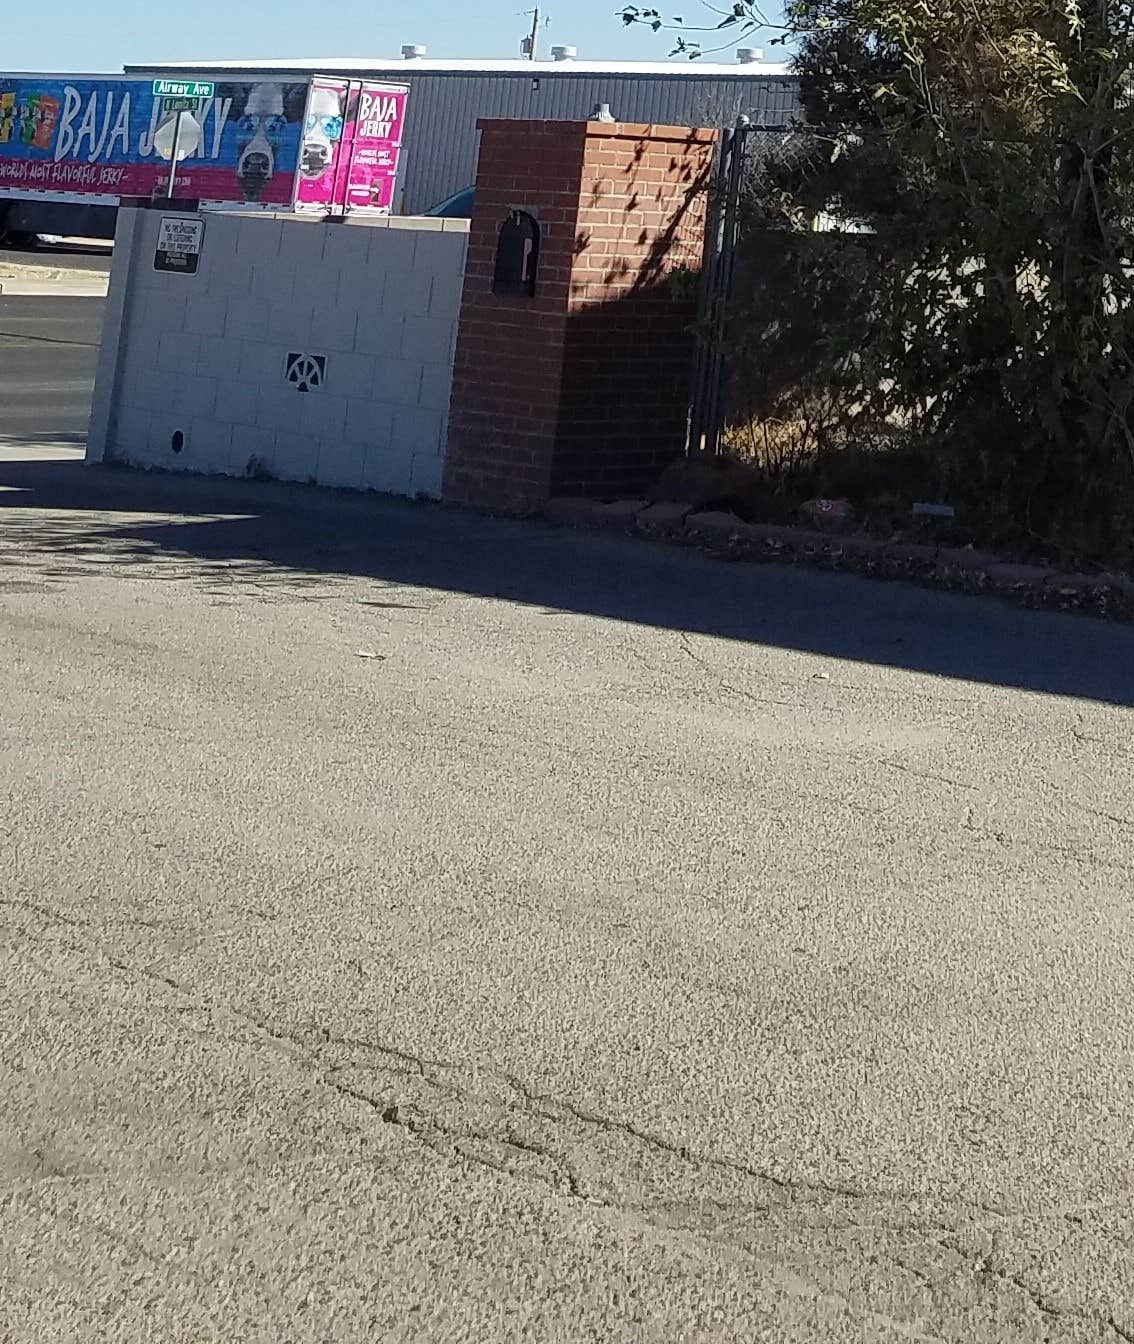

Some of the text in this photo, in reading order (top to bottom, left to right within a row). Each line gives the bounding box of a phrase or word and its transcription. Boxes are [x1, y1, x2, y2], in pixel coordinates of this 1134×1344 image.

[157, 81, 210, 96] Airway Ave
[360, 93, 397, 121] BAJA
[54, 85, 233, 163] BAJA JKY
[360, 121, 392, 138] JERKY
[29, 163, 54, 182] MOST
[52, 162, 97, 186] FLAVORFUL
